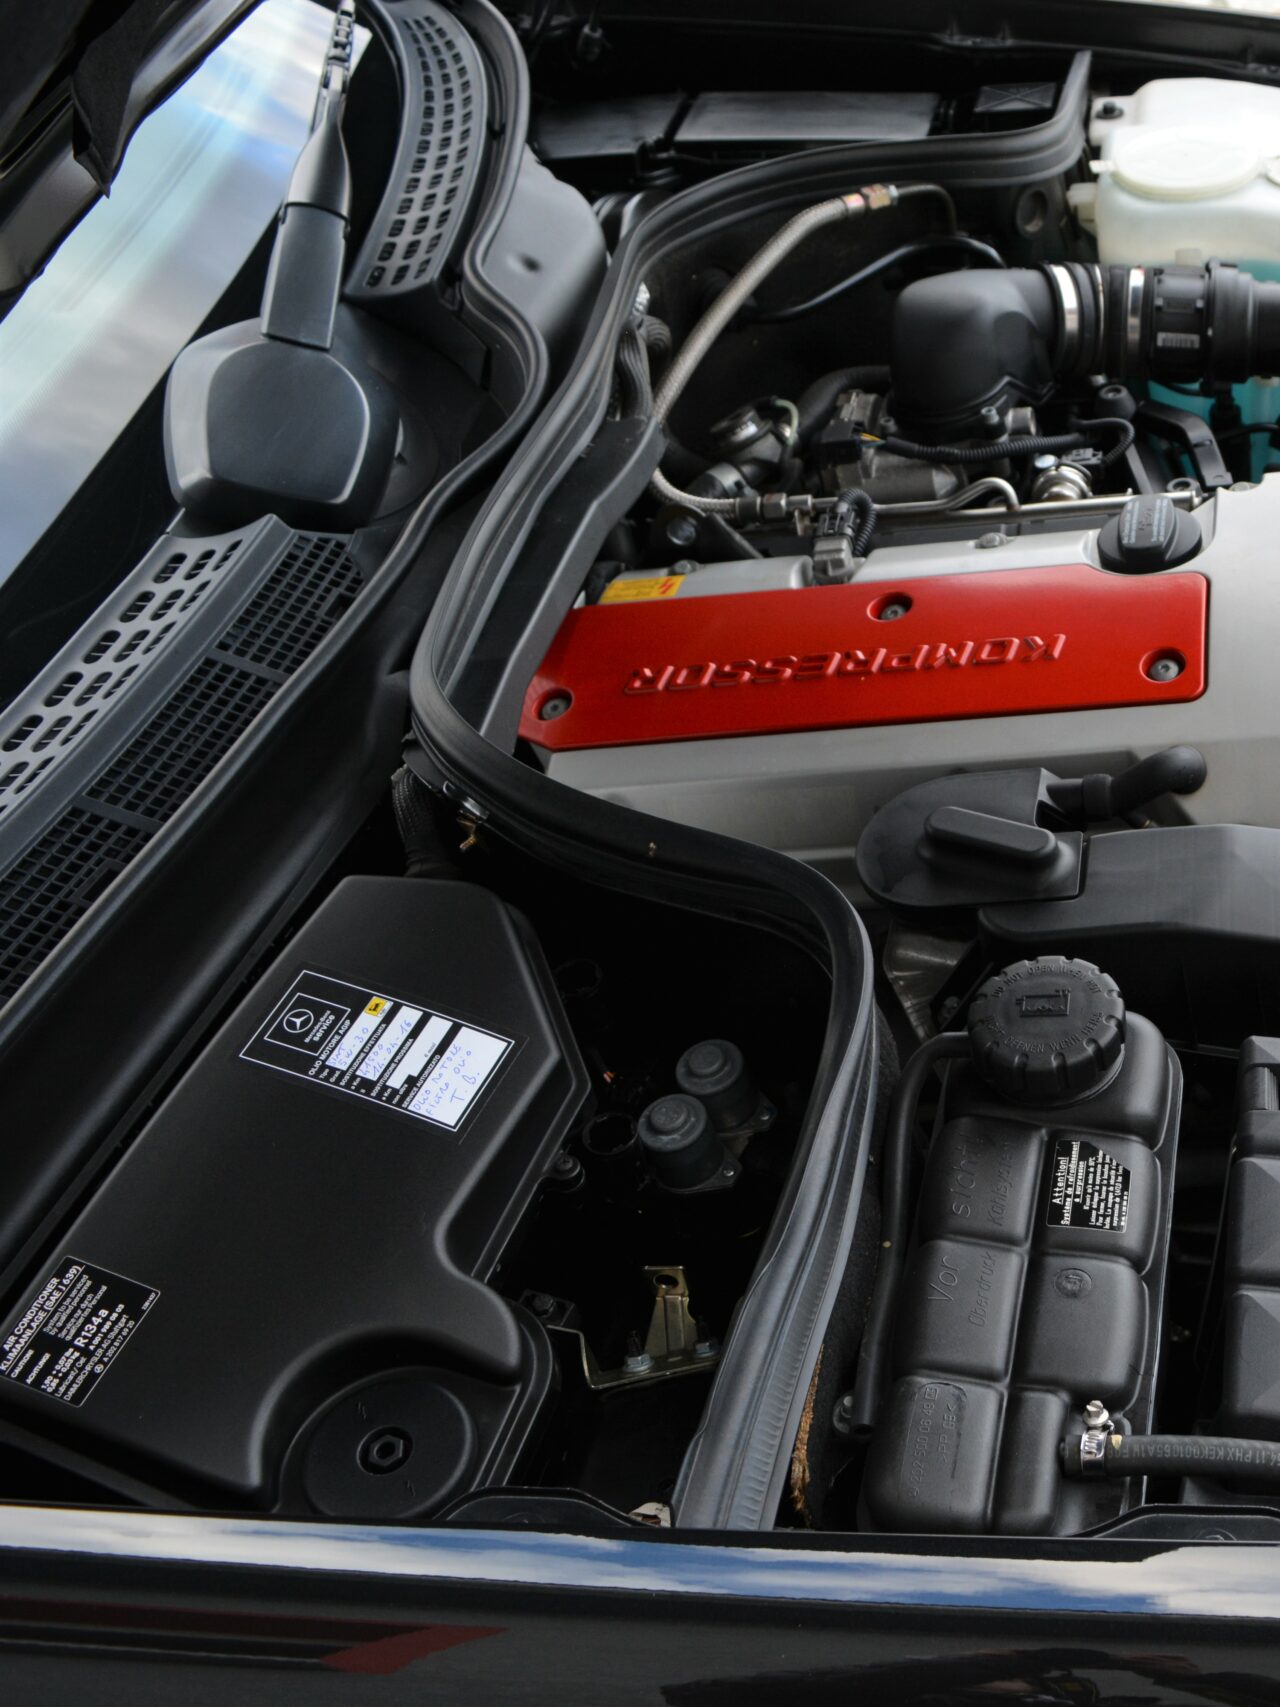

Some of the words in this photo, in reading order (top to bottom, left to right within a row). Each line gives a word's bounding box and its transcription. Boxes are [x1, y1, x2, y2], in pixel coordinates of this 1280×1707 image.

[623, 633, 1067, 696] KOMPRESSOR
[307, 1060, 323, 1075] OLIO
[318, 1033, 341, 1060] MOTORE
[336, 1018, 352, 1034] AGIP
[311, 1013, 336, 1041] service
[338, 1052, 366, 1086] SOSTITUZIONE
[362, 1022, 387, 1052] EFFETTUATA
[318, 1068, 330, 1079] Tipo
[370, 1062, 397, 1096] SOSTITUZIONE
[393, 1037, 414, 1062] PROSSIMA
[401, 1086, 419, 1107] SERVICE
[415, 1054, 441, 1087] AUTORIZZATO
[1051, 1157, 1066, 1203] Attention!
[2, 1335, 18, 1351] AIR
[13, 1276, 60, 1335] CONDITIONER
[68, 1274, 89, 1297] serviced
[0, 1309, 47, 1371] KLIMAANLAGE
[42, 1289, 63, 1310] (SAE
[60, 1264, 81, 1285] 639)
[73, 1307, 109, 1347] R134a
[64, 1348, 105, 1400] DAIMLERCHRYSLER
[101, 1339, 111, 1348] AG
